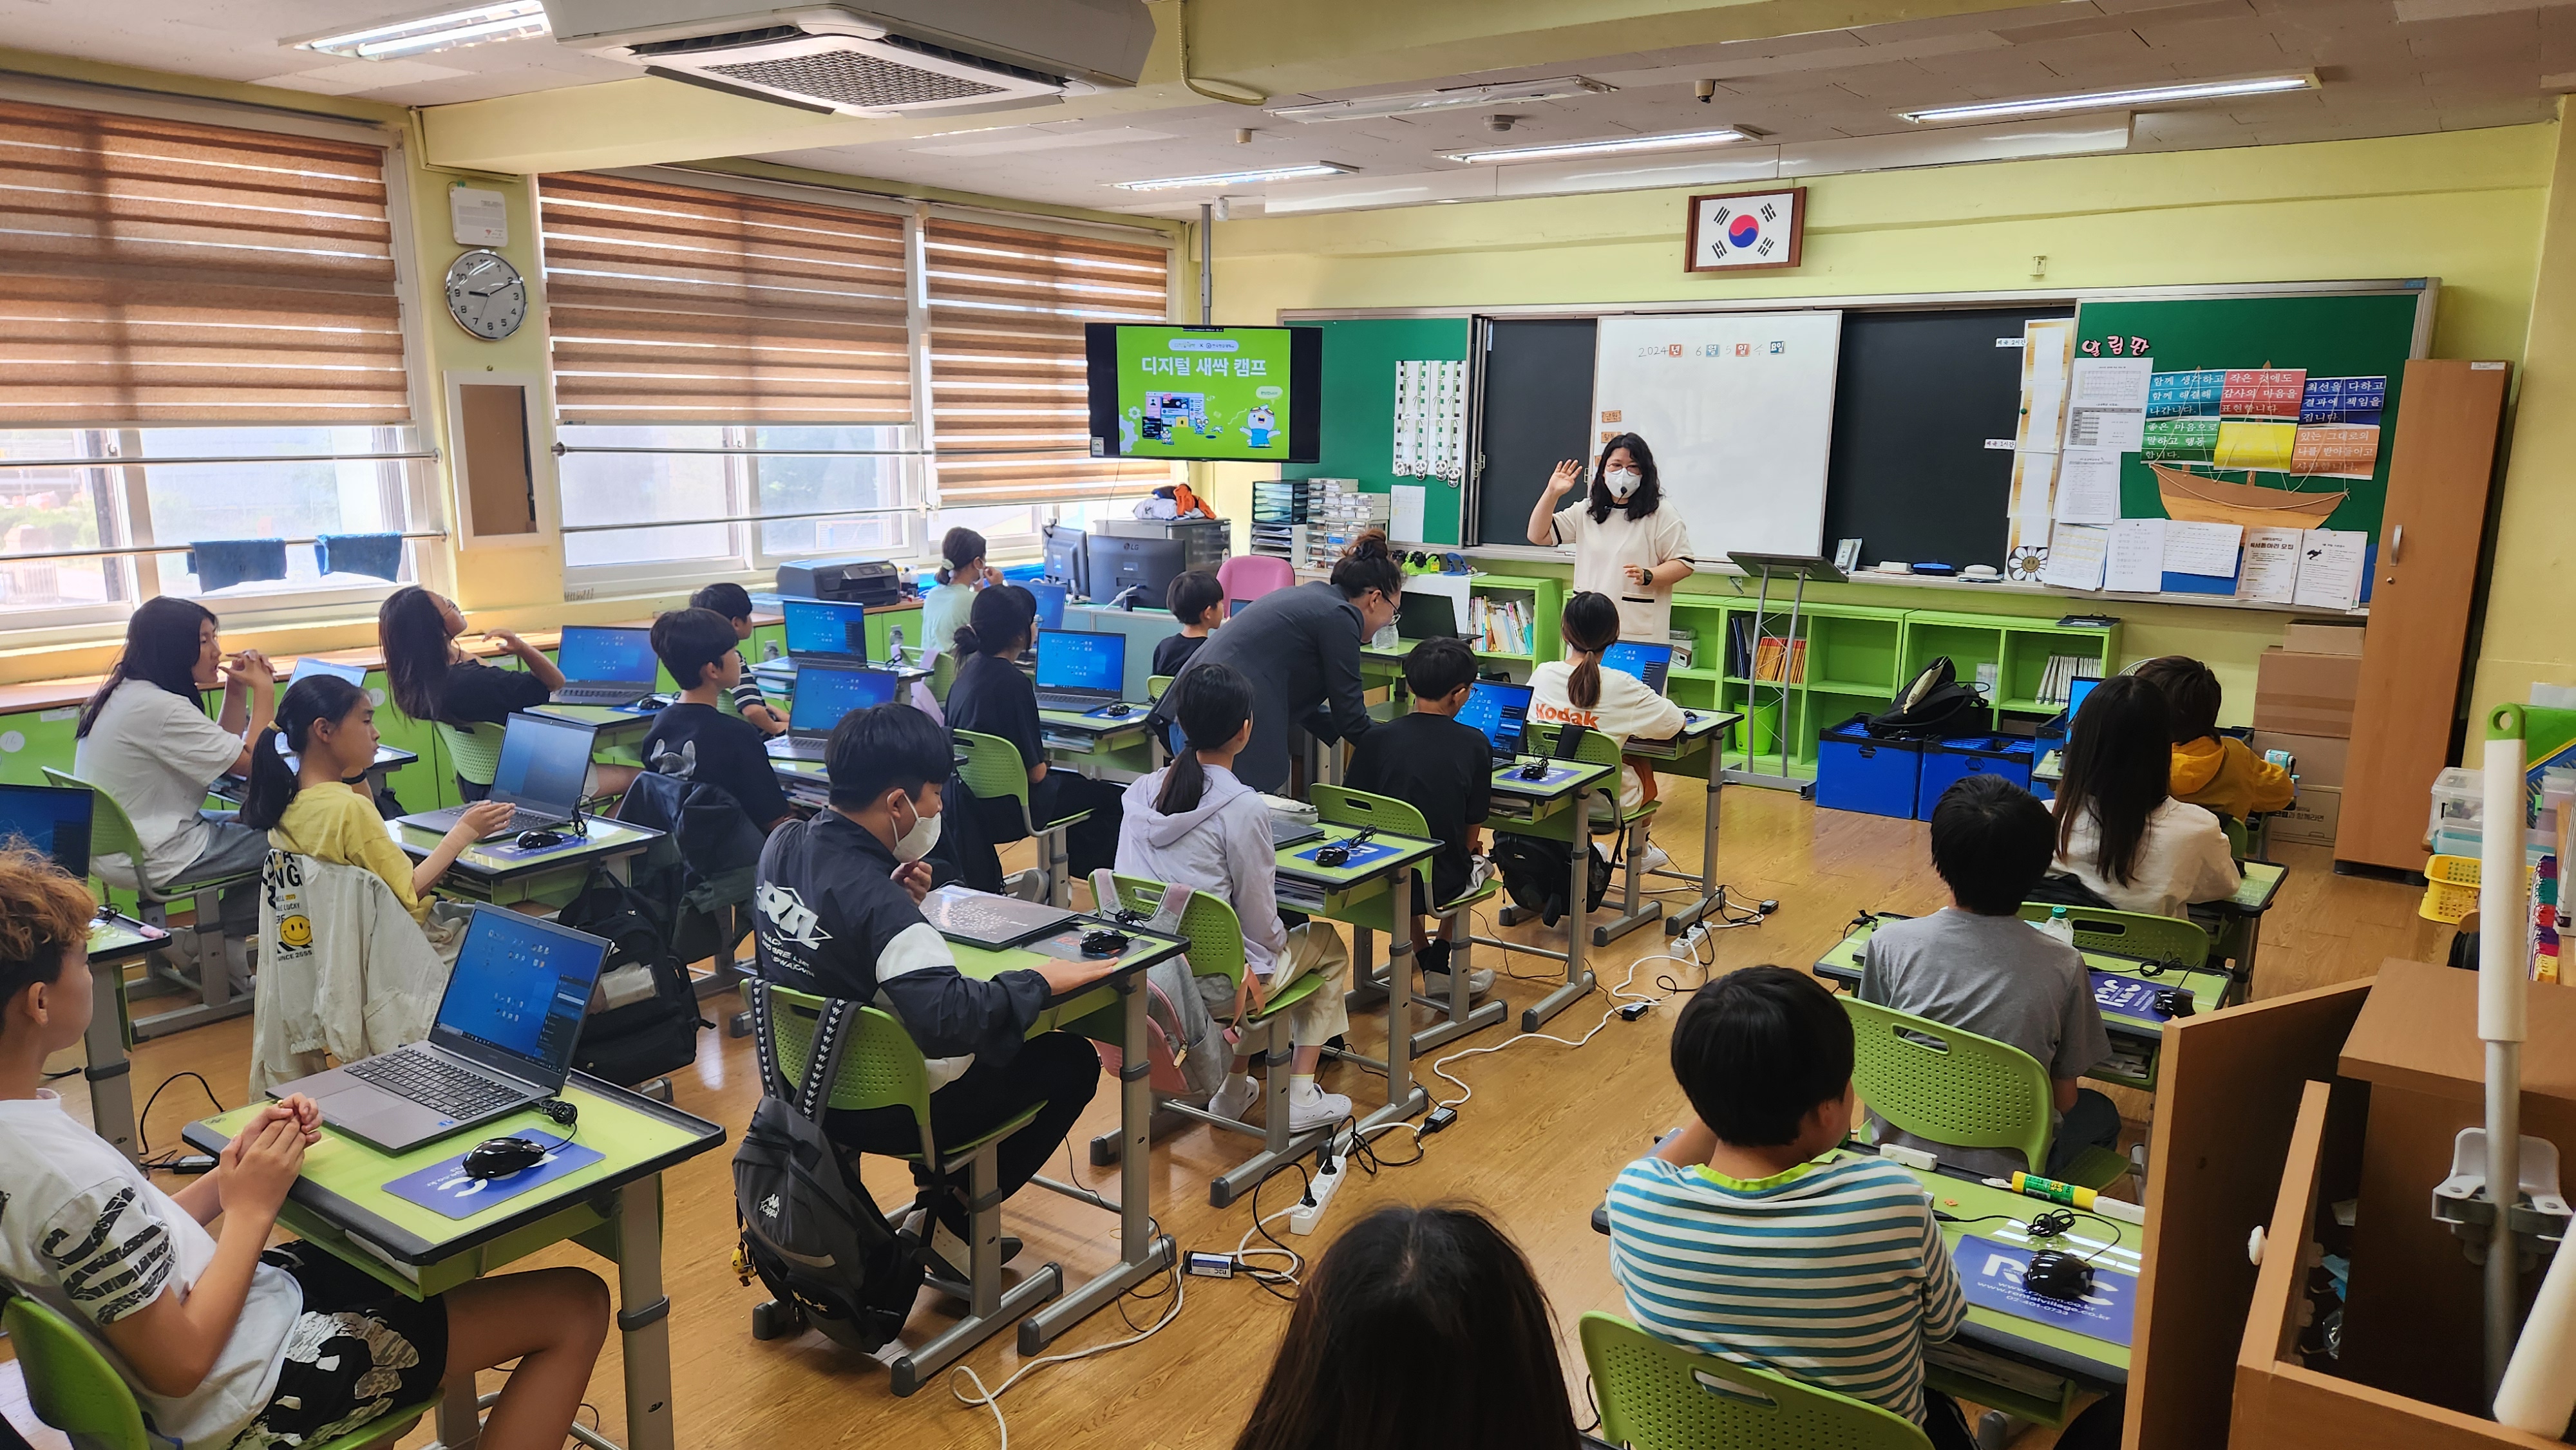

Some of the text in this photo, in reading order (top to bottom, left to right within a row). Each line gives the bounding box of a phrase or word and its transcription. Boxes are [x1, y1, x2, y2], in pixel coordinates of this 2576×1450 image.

[2081, 335, 2150, 357] 알림판
[1142, 356, 1267, 377] 디지털 새싹 캠프
[2154, 372, 2224, 386] 함께 생각하고
[2230, 373, 2293, 384] 작은 것에도
[2307, 381, 2384, 392] 최선을 다하고
[2152, 390, 2172, 400] 함께
[2224, 388, 2298, 399] 감사의 마음을
[2304, 396, 2382, 408] 결과에 책임을
[2303, 413, 2341, 422] 집니다.
[2175, 422, 2218, 432] 마음으로
[2301, 431, 2369, 441] 있는 그대로의
[2147, 437, 2206, 447] 말하고 행동
[1535, 703, 1600, 730] Kodak
[283, 902, 300, 911] LUCKY
[759, 1204, 778, 1219] Kappa
[2006, 1295, 2069, 1315] 02-401-0733
